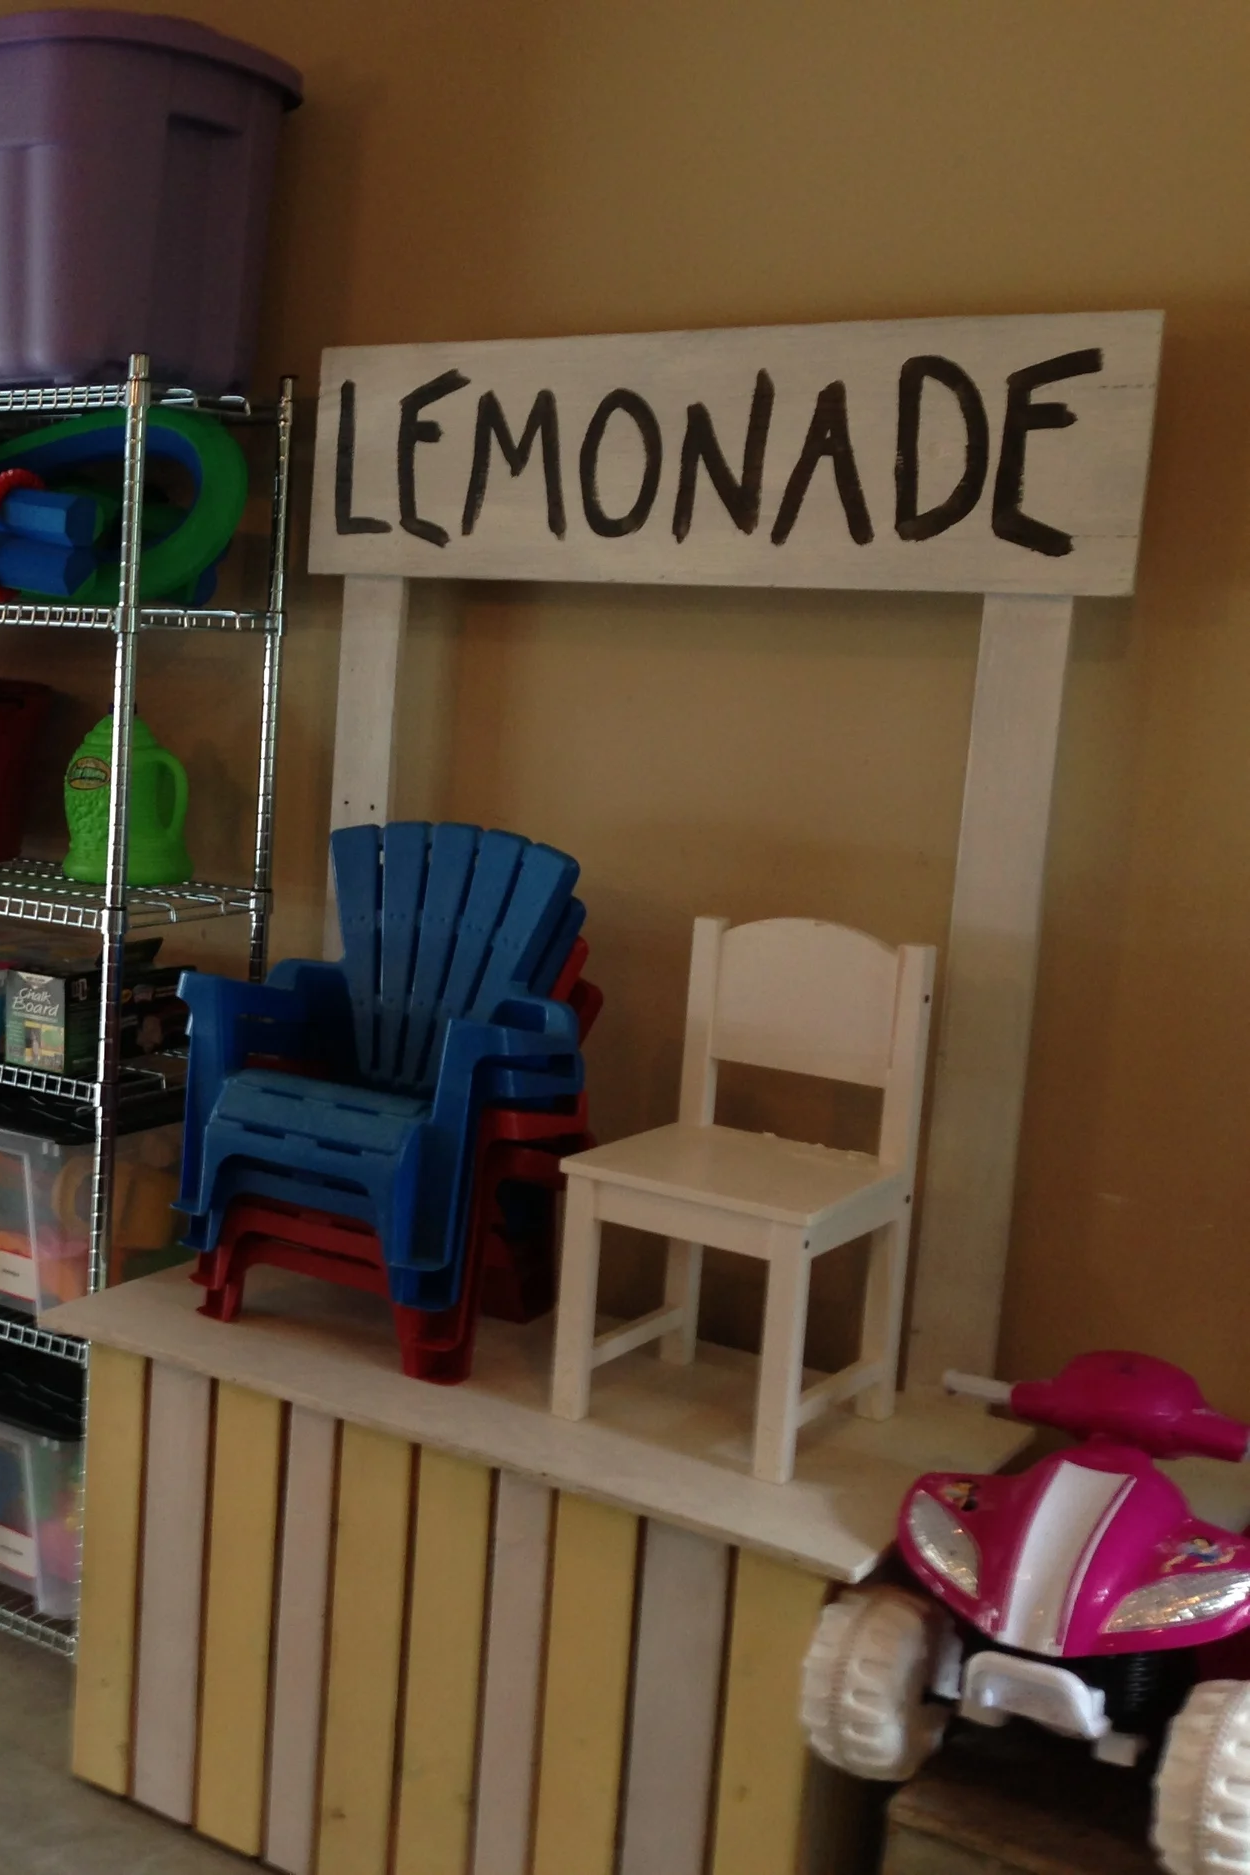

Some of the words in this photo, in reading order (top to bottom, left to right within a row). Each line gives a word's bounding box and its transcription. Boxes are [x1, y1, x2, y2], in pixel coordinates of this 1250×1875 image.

[334, 347, 1104, 557] LEMONADE
[19, 987, 51, 1004] Chalk
[12, 996, 59, 1016] Board
